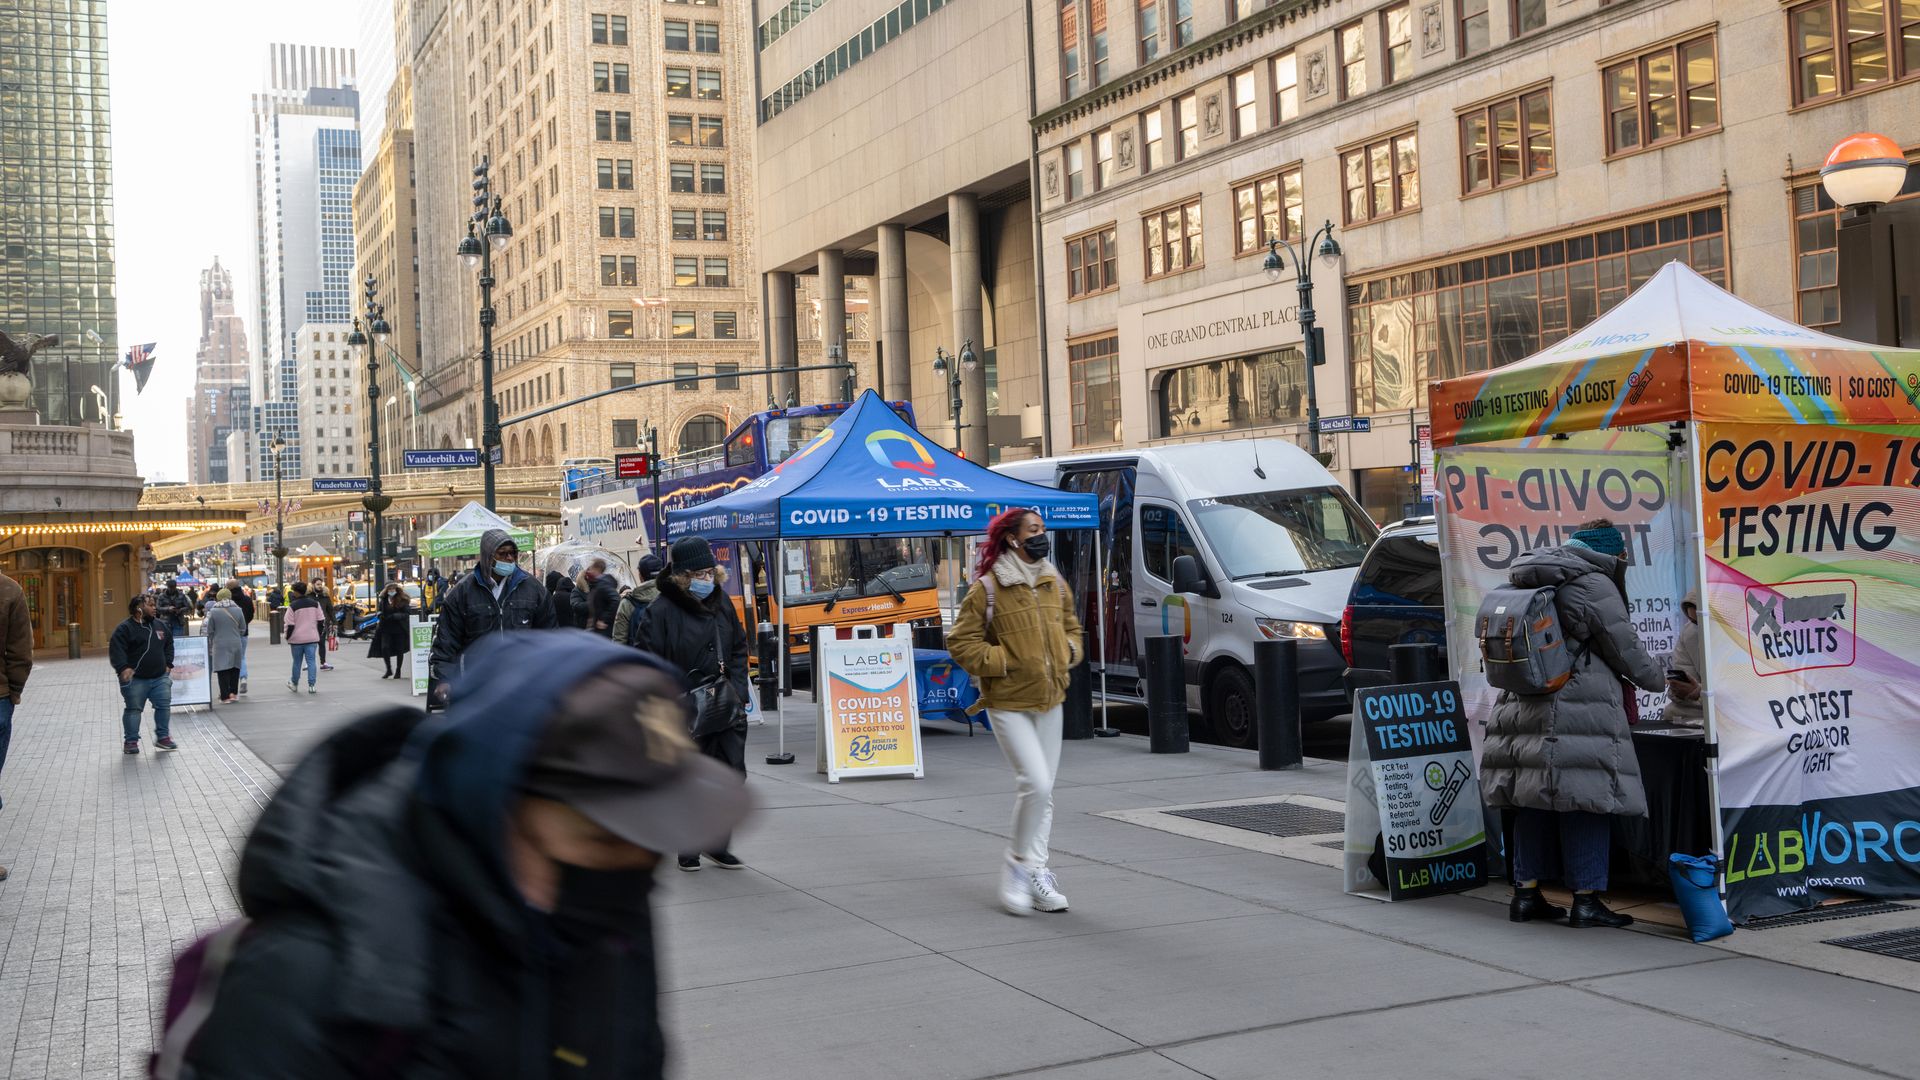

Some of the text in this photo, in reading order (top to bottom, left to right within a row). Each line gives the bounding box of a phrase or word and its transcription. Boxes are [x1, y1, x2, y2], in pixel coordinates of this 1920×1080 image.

[1147, 332, 1168, 350] ONE
[1170, 324, 1207, 345] GRAND
[1208, 314, 1260, 337] CENTRAL
[1724, 373, 1898, 399] COVID-19 TESTING $0 COST
[1454, 379, 1617, 420] COVID-19 TESTING $0 COST
[1320, 421, 1331, 430] East
[1332, 420, 1344, 428] 42nd
[1344, 419, 1350, 427] St
[407, 452, 475, 464] Vanderbilt Ave
[315, 481, 367, 489] Vanderbilt Ave
[876, 477, 971, 489] LABQ
[1198, 498, 1218, 507] 124
[790, 508, 850, 525] COVID
[867, 507, 888, 522] 19
[893, 504, 973, 521] TESTING
[691, 519, 698, 532] 19
[700, 514, 728, 531] TESTING
[1719, 501, 1897, 559] TESTING
[1221, 613, 1233, 623] 124
[1762, 626, 1838, 660] RESULTS
[843, 651, 892, 666] LABQ
[838, 695, 902, 710] COVID-19
[1364, 689, 1457, 722] COVID-19
[838, 710, 904, 725] TESTING
[862, 725, 880, 733] COST
[1375, 719, 1458, 750] TESTING
[849, 740, 871, 757] 24
[871, 743, 898, 751] HOURS
[1381, 762, 1409, 772] PCR Test
[1384, 772, 1414, 781] Antibody
[1385, 782, 1408, 791] Testing
[1386, 791, 1413, 801] No Cost
[1388, 800, 1421, 811] No Doctor
[1390, 809, 1415, 819] Referral
[1391, 818, 1421, 829] Required
[1388, 829, 1444, 853] $0 COST
